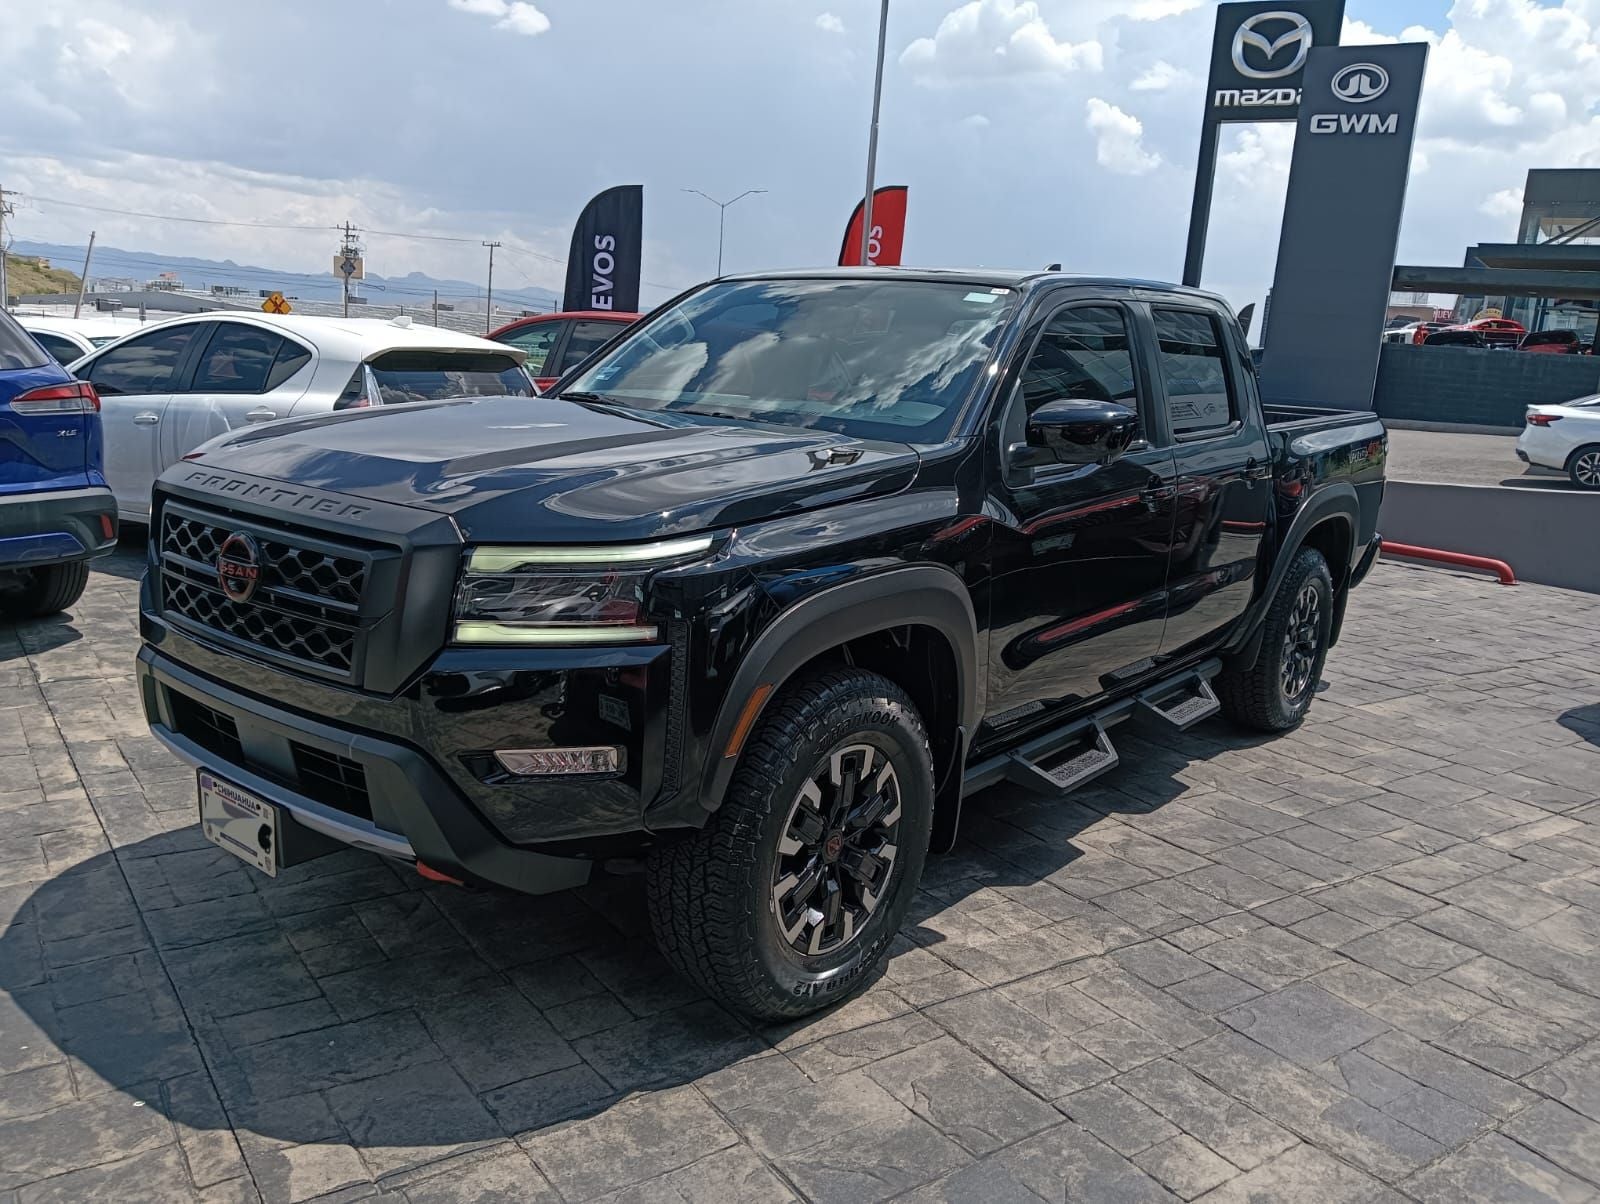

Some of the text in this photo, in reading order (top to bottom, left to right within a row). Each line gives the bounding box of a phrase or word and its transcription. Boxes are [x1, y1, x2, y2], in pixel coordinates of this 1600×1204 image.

[1310, 113, 1399, 134] GWM
[57, 429, 78, 437] XLE
[184, 471, 372, 519] FRONTIER
[217, 783, 257, 811] CHIHUAHUA
